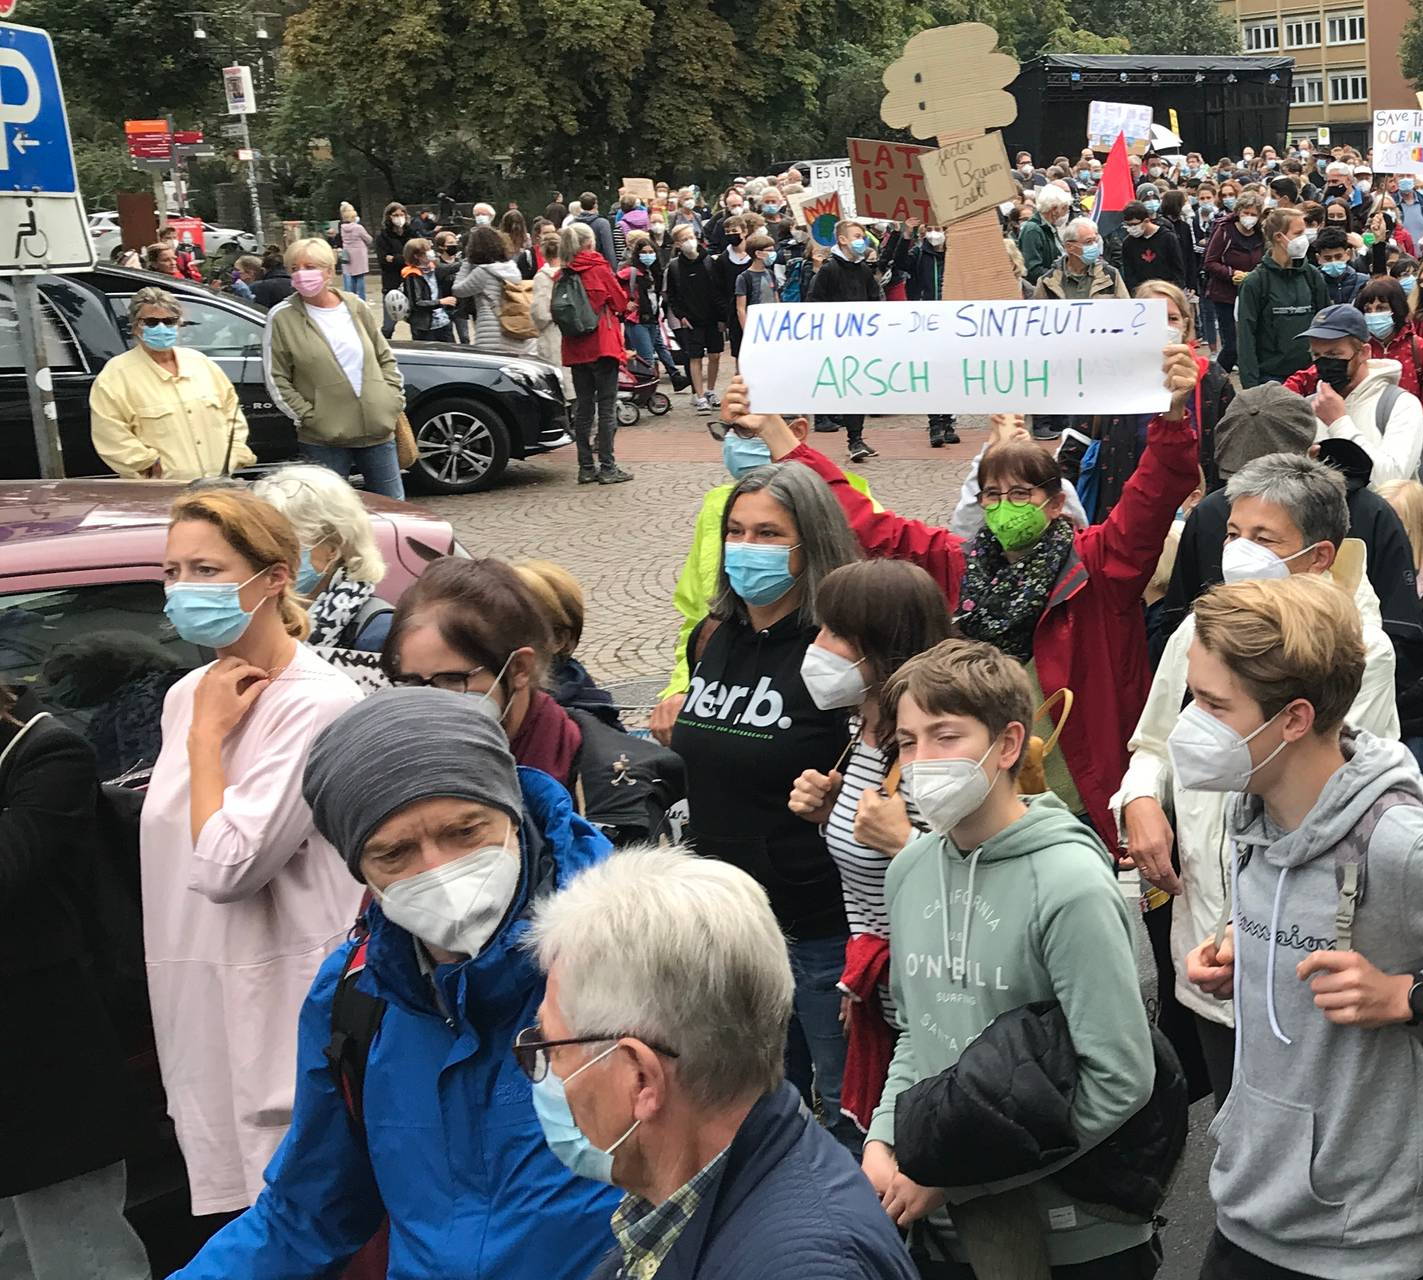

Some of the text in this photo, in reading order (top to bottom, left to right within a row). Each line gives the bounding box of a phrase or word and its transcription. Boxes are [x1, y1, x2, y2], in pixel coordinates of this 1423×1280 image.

[0, 47, 41, 170] P
[1378, 130, 1422, 145] OCEAN
[816, 165, 852, 179] ES IST
[863, 169, 889, 191] IS
[953, 158, 1003, 188] Baum
[753, 310, 824, 344] NACH
[834, 311, 881, 338] UNS
[908, 310, 940, 333] DIE
[812, 355, 930, 399] ARSCH
[963, 359, 1050, 398] HUH
[906, 953, 1009, 990] O'NEILL
